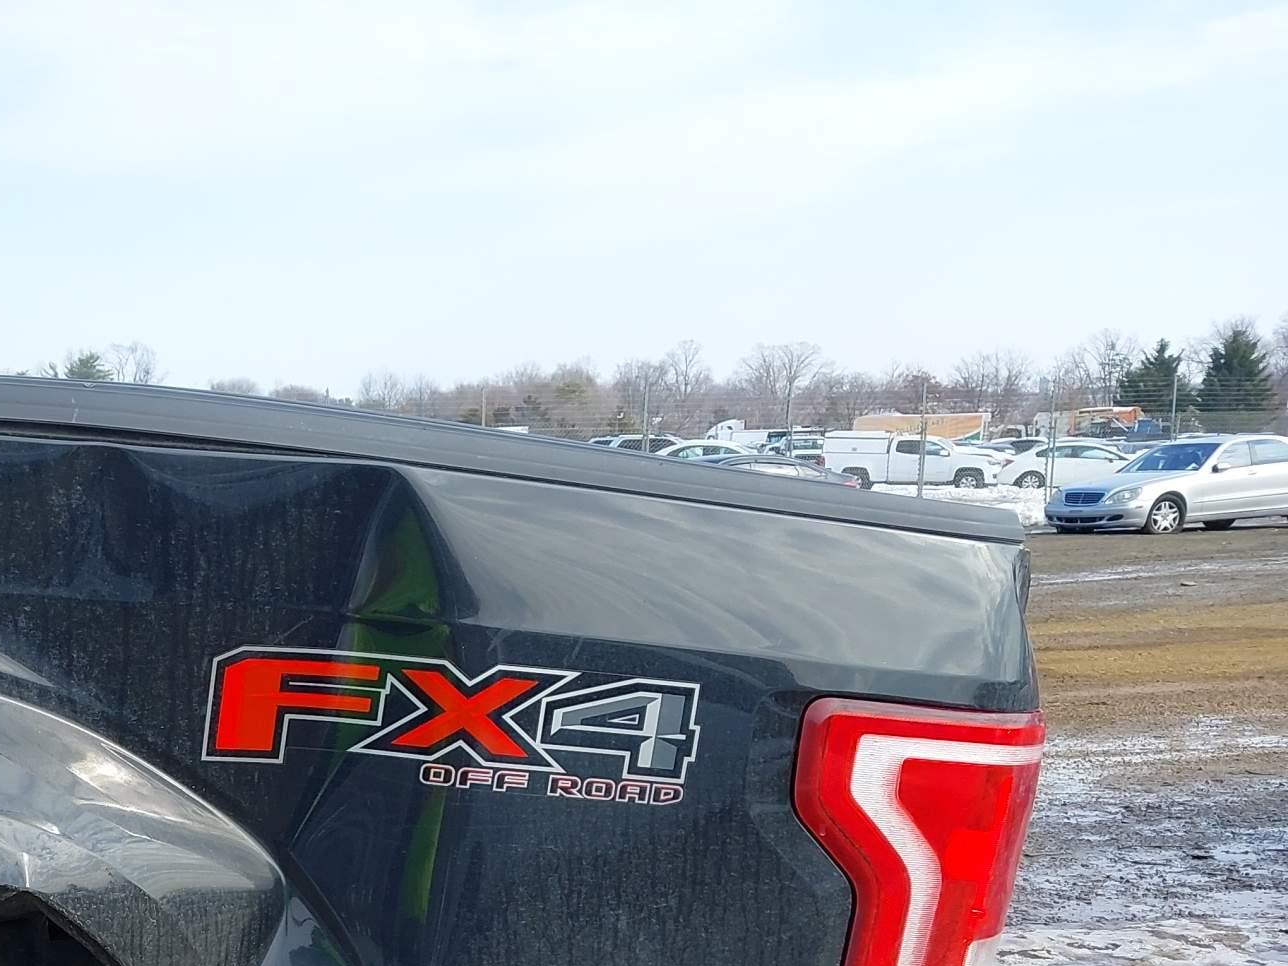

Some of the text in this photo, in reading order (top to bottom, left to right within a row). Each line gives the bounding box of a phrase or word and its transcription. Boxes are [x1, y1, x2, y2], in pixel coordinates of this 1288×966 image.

[201, 646, 700, 783] FX4
[420, 763, 683, 805] OFF ROAD
